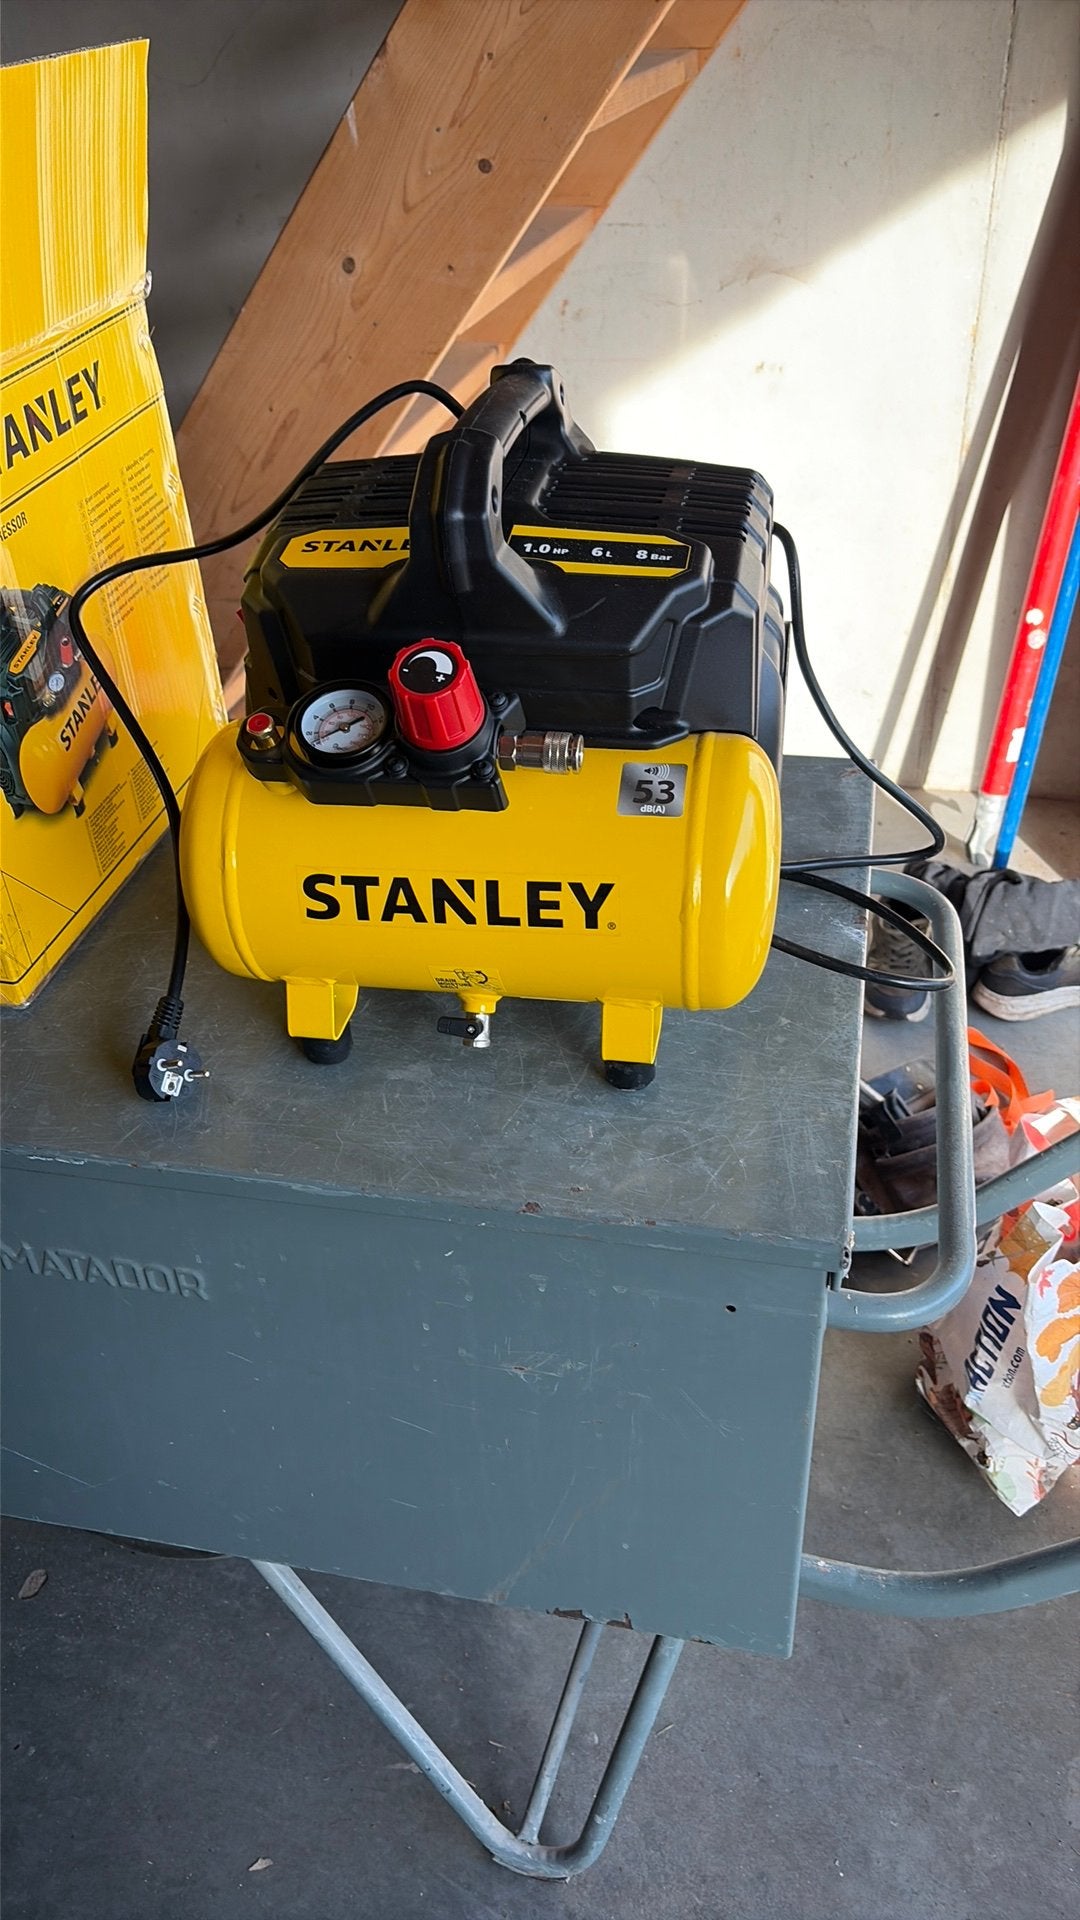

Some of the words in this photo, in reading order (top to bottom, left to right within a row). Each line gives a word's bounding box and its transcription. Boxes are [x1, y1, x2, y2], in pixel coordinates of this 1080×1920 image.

[0, 360, 101, 475] ANLEY
[523, 543, 551, 554] 1.0
[591, 547, 603, 557] 6
[636, 550, 648, 560] 8
[650, 553, 673, 561] Bar
[13, 634, 38, 669] STANLEY
[632, 780, 675, 805] 53
[640, 804, 666, 814] dB(A)
[302, 873, 615, 930] STANLEY
[0, 1240, 209, 1300] MATADOR
[964, 1284, 1022, 1393] ACTION
